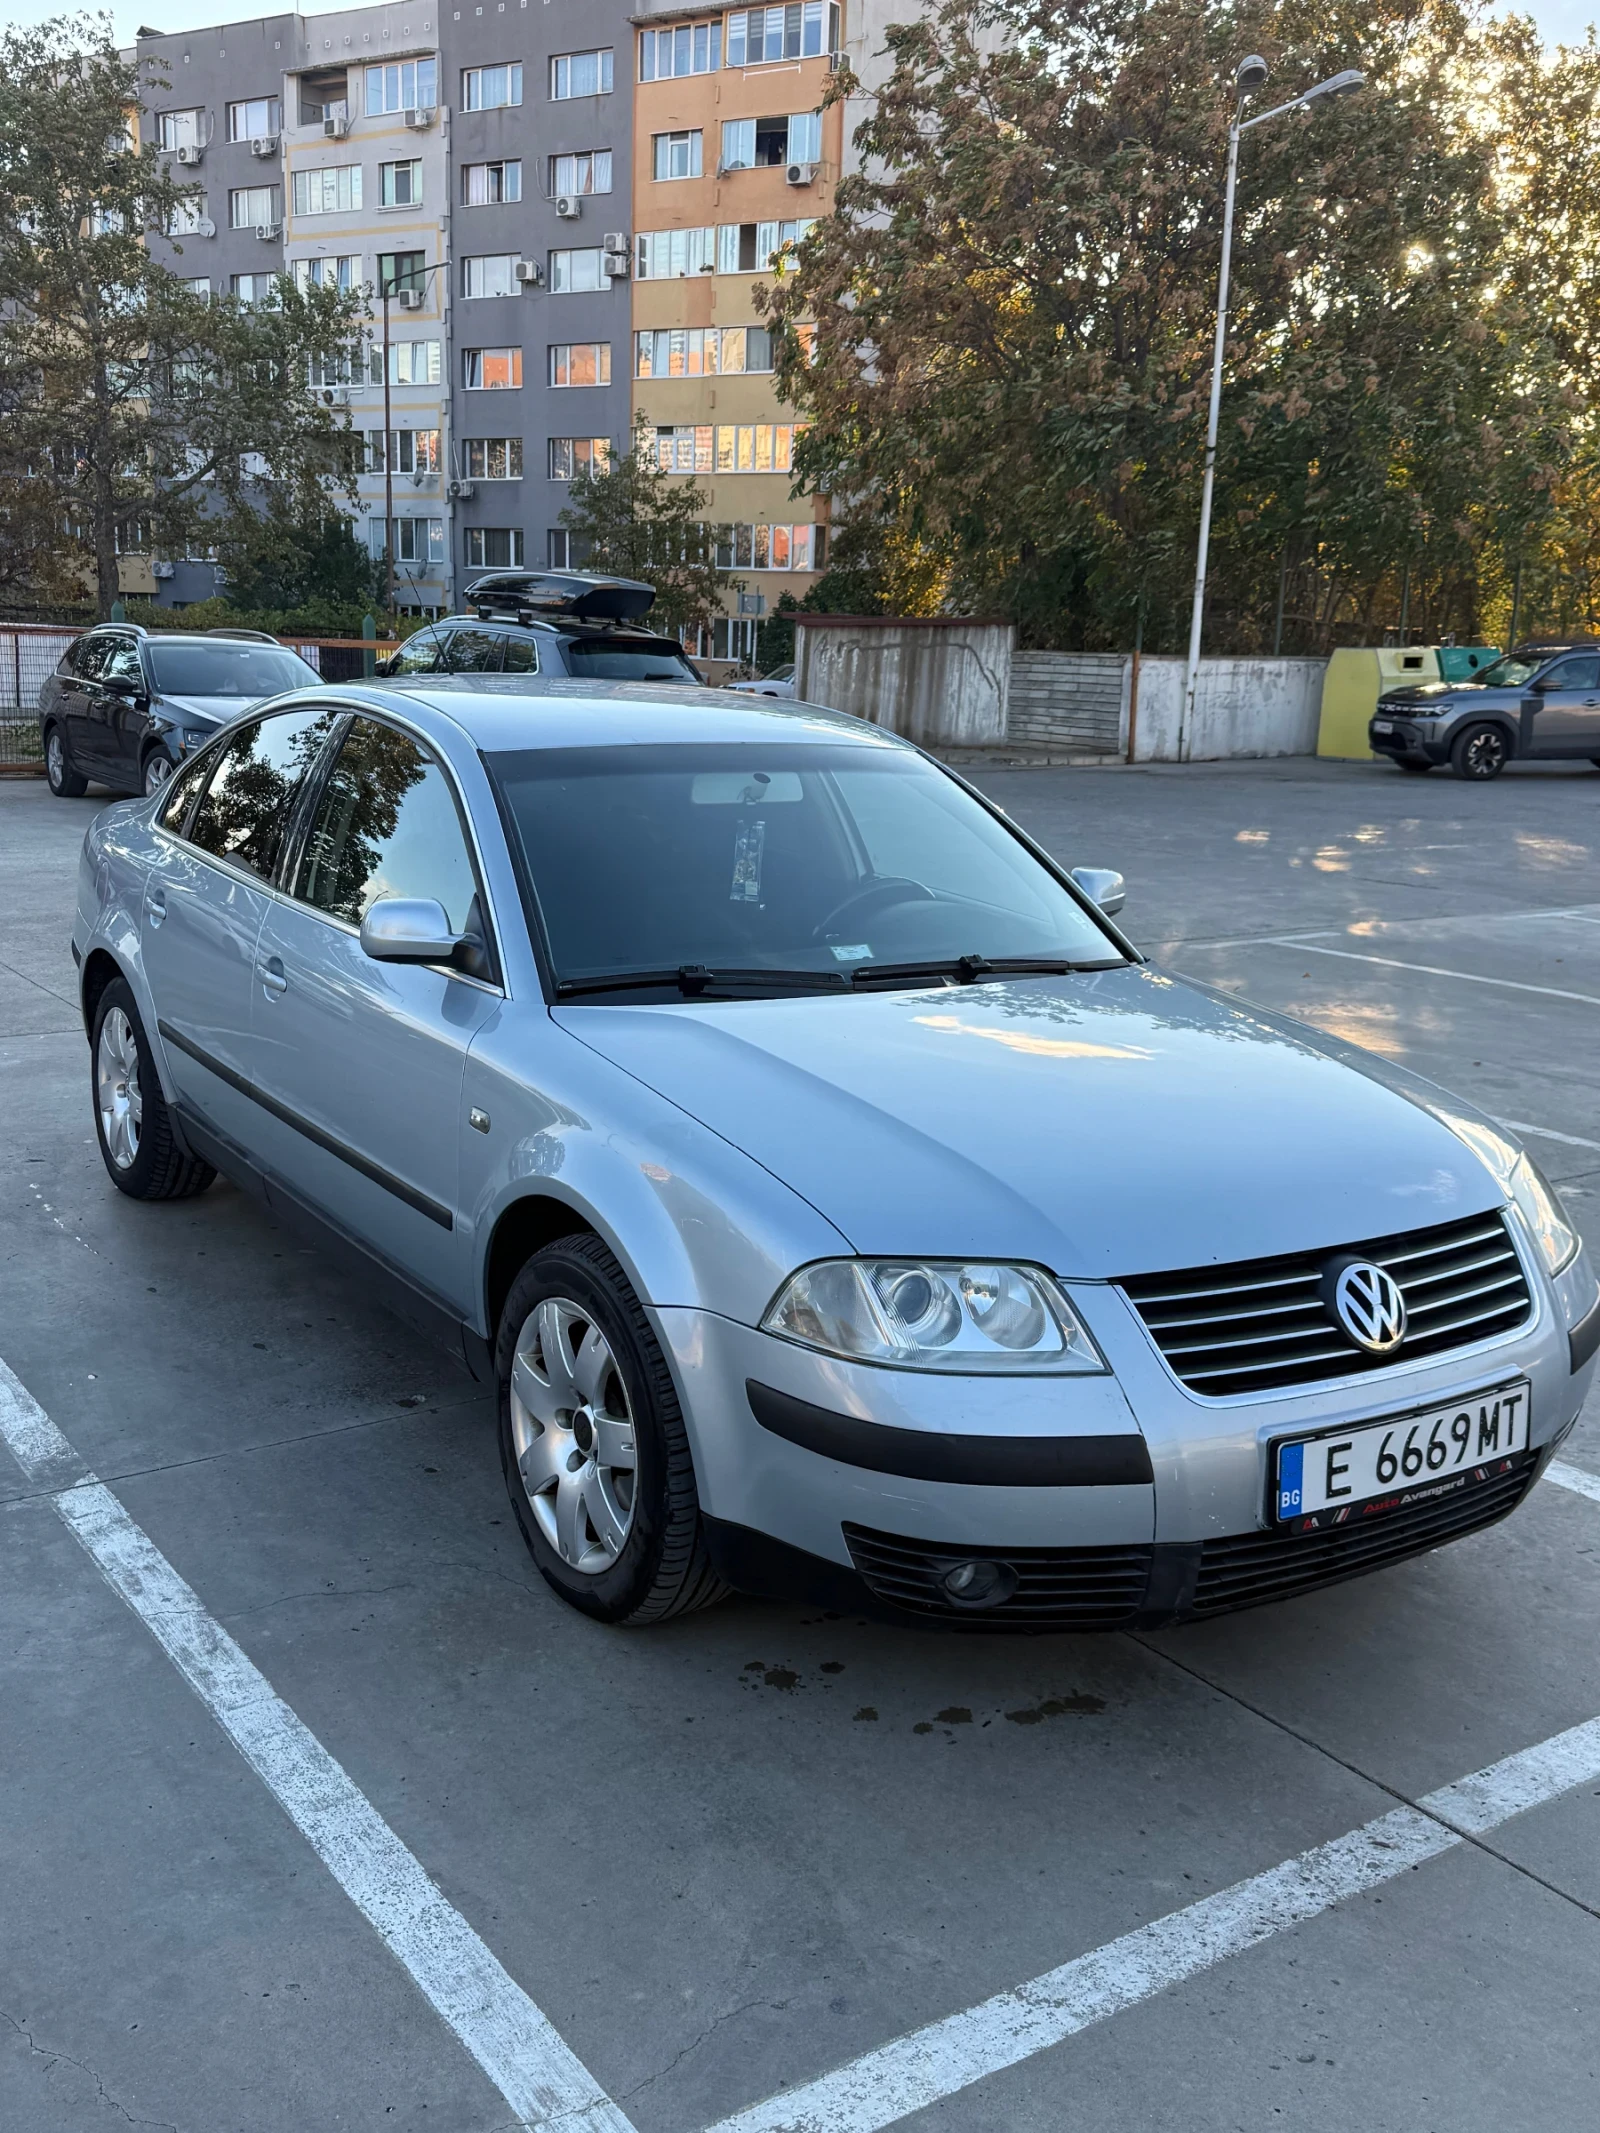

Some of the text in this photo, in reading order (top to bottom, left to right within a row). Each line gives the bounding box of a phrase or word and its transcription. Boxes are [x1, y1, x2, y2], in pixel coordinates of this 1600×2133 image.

[1336, 1263, 1405, 1351] VW
[1325, 1441, 1352, 1499] E
[1400, 1477, 1465, 1504] Avangard
[1281, 1489, 1300, 1508] BG
